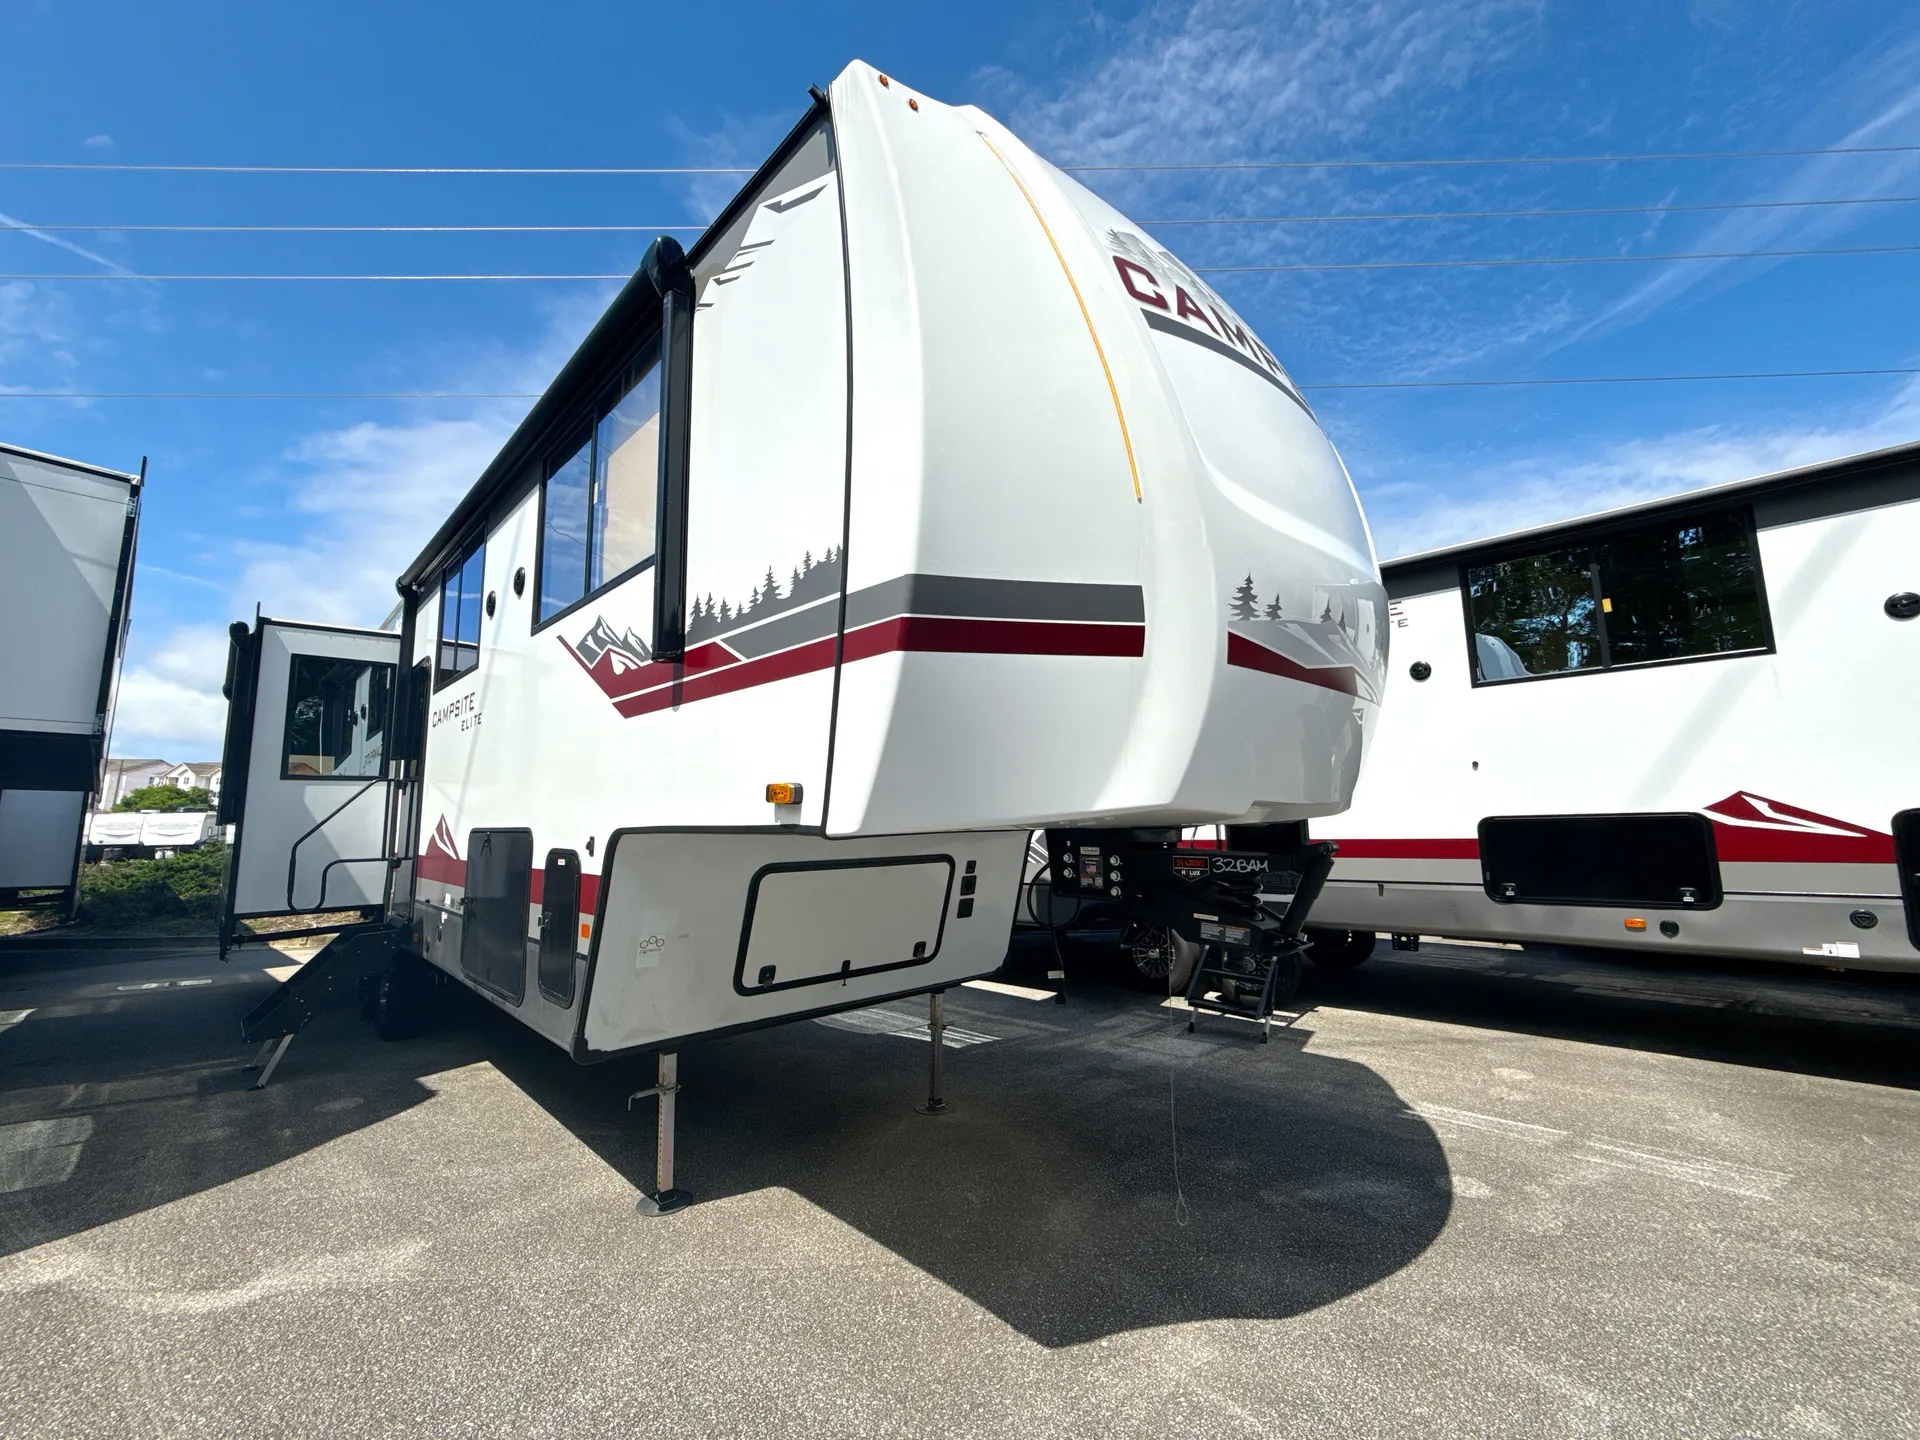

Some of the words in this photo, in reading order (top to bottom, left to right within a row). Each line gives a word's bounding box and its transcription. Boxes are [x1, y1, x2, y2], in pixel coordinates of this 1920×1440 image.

[1112, 255, 1292, 385] CAMP
[432, 692, 476, 728] CAMPSITE
[461, 712, 482, 732] ELITE
[1212, 857, 1270, 873] 32BAM
